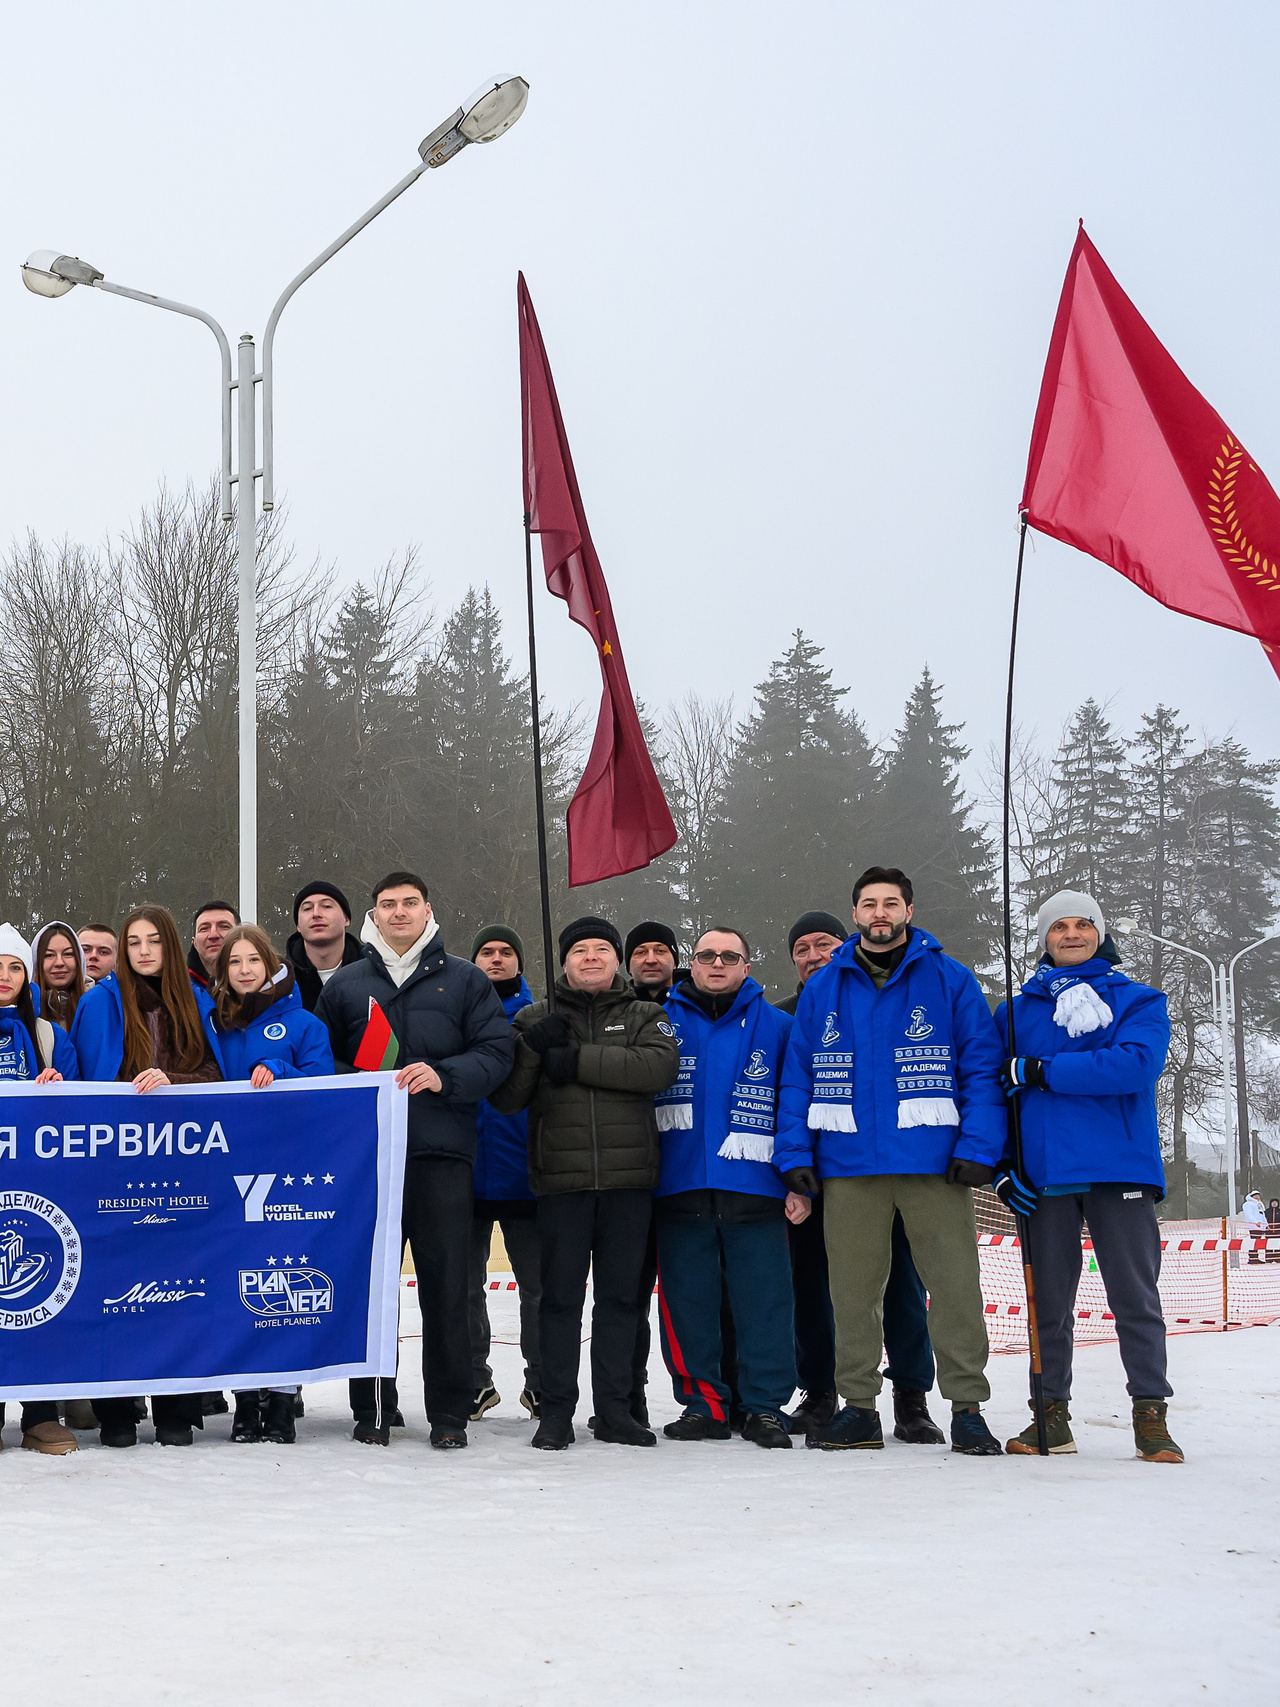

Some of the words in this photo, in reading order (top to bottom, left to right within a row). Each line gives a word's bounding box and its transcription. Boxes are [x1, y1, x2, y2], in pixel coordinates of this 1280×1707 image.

[901, 1063, 947, 1073] АКАДЕМИЯ
[34, 1121, 230, 1159] СЕРВИСА
[98, 1196, 165, 1209] PRESIDENT
[169, 1195, 210, 1206] HOTEL
[264, 1204, 303, 1213] HOTEL
[265, 1210, 336, 1222] YUBILEINY
[103, 1305, 146, 1314] HOTEL
[254, 1318, 282, 1329] HOTEL
[283, 1316, 322, 1326] PLANETA
